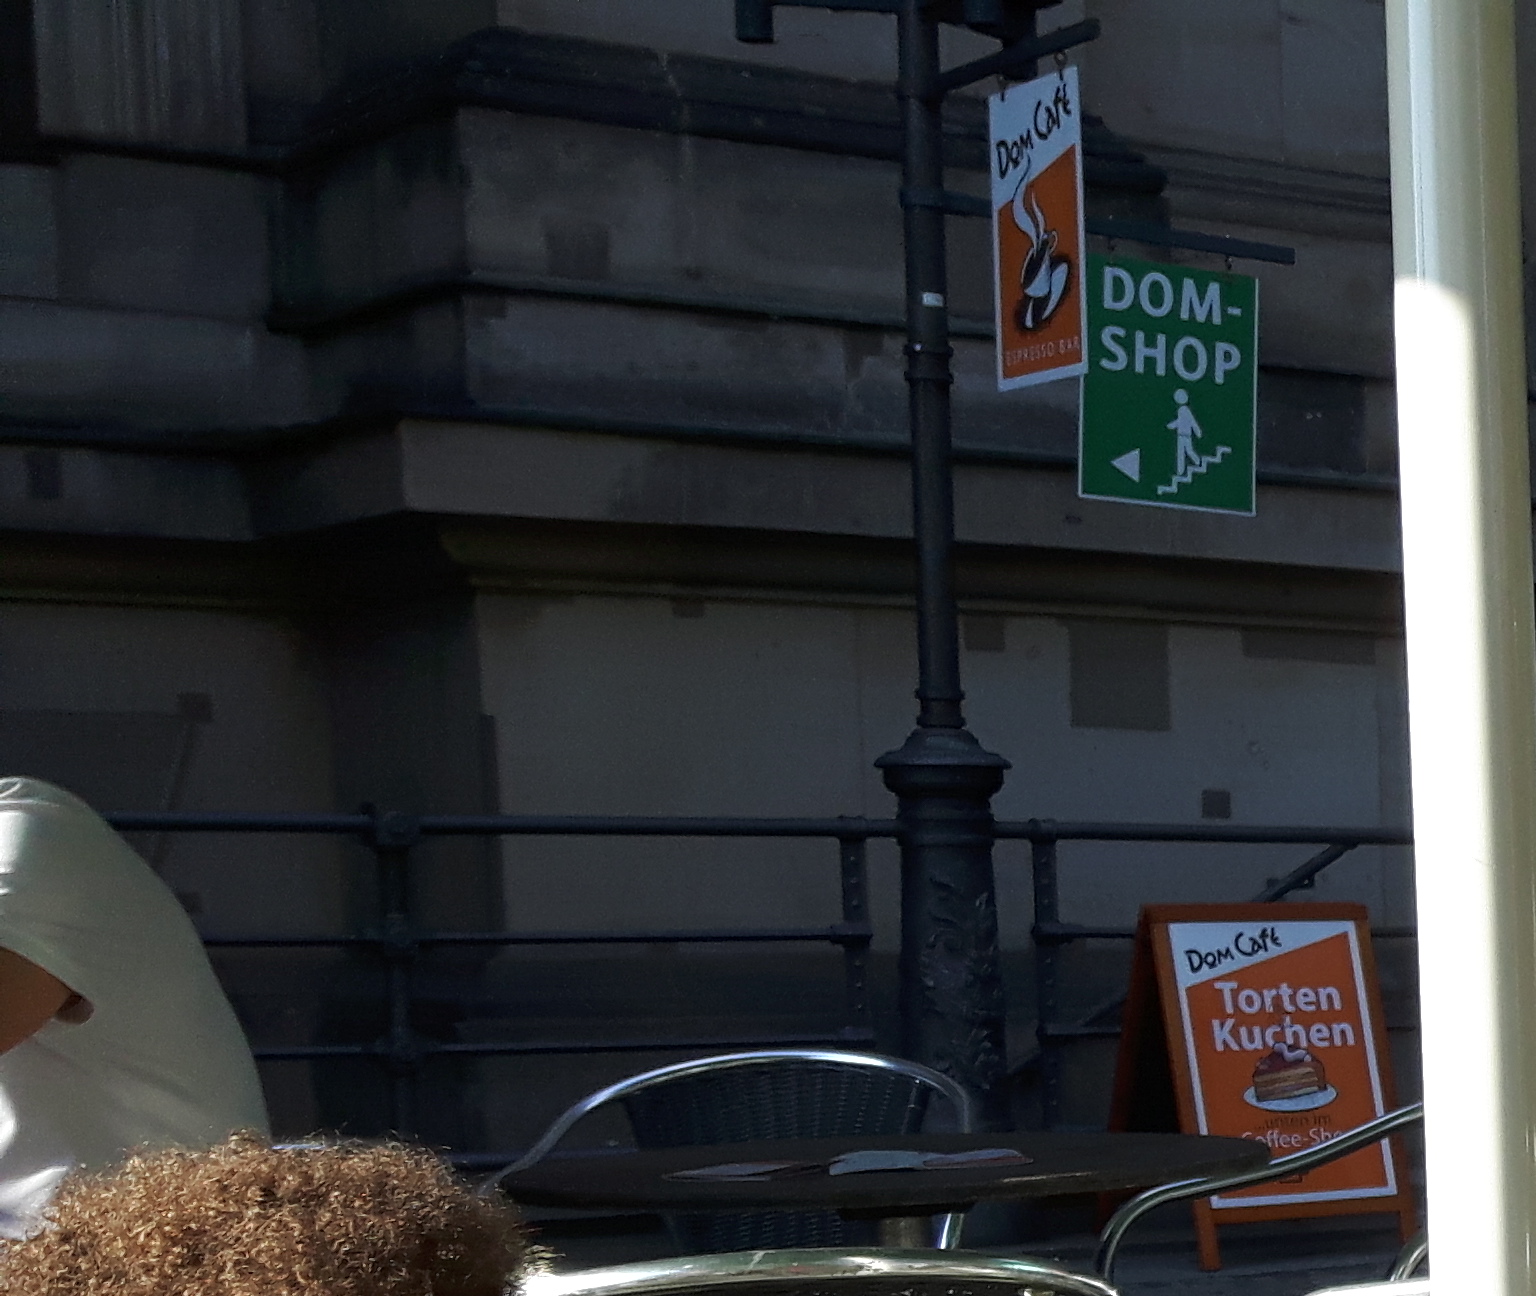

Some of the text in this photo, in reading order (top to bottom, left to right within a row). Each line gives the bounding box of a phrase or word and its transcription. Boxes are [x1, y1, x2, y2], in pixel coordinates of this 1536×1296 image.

[1103, 266, 1242, 325] DOM-
[1005, 341, 1054, 367] ESPRESSO
[1100, 325, 1241, 385] SHOP
[1213, 981, 1342, 1015] Torten
[1211, 1015, 1356, 1052] Kuchen
